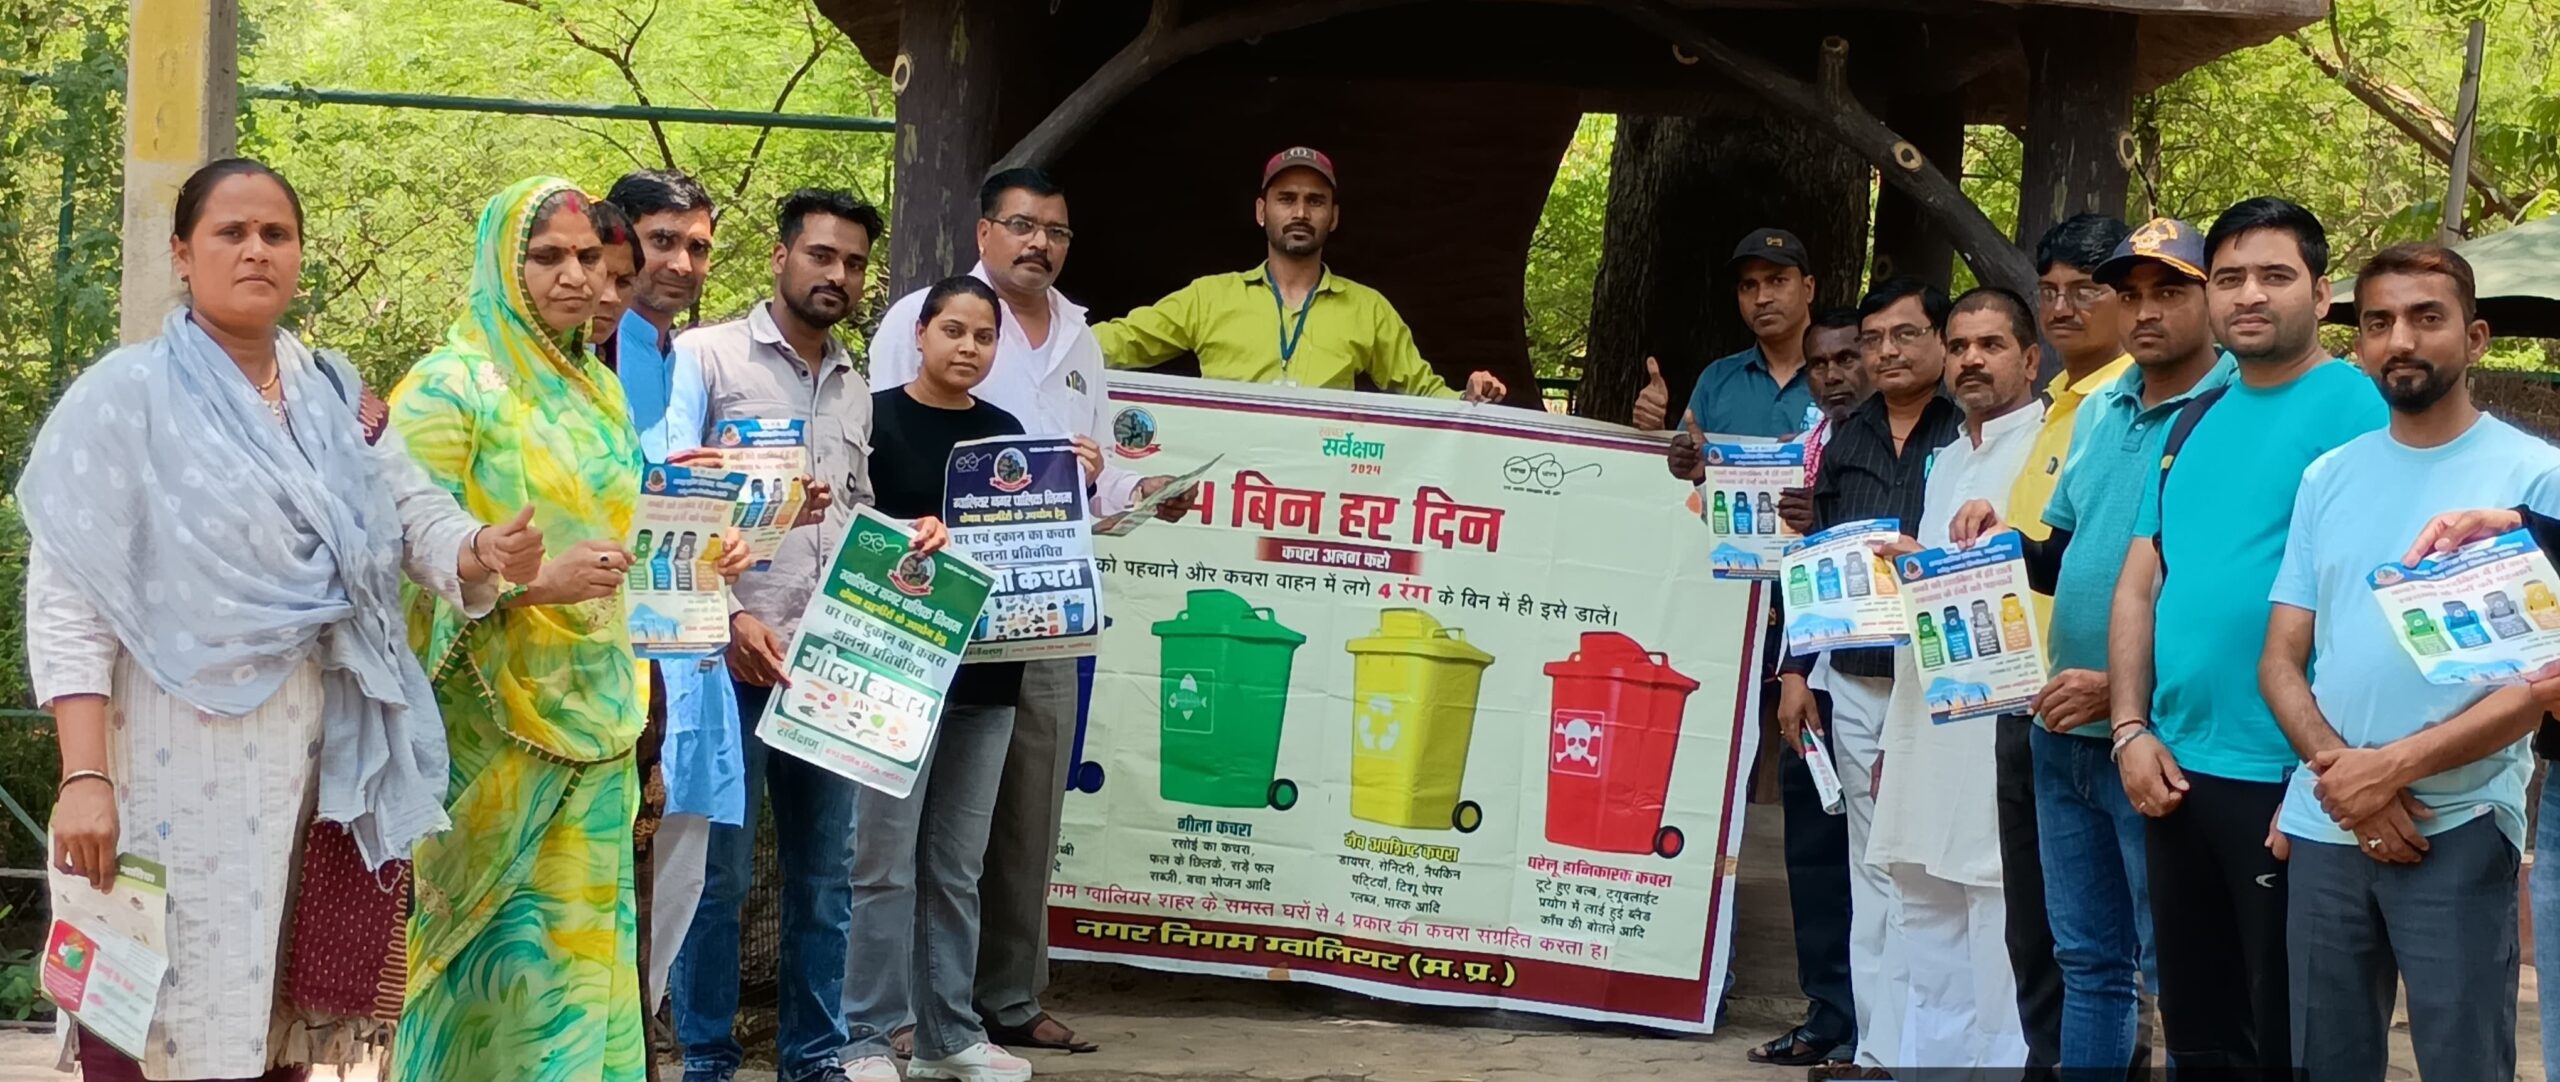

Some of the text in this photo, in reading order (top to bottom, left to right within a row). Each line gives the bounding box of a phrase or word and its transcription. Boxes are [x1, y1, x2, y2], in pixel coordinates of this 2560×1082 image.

[1322, 432, 1385, 460] सर्वेक्षण
[1351, 463, 1381, 476] 2024
[1231, 470, 1325, 535] बिन
[1339, 491, 1400, 541] हर
[1412, 486, 1505, 552] दिन
[954, 528, 1076, 547] घर एवं दुकान का कचरा
[1281, 545, 1391, 570] कचरा अलग करो
[1015, 565, 1082, 591] कचरा
[1123, 559, 1178, 580] पहचाने
[1185, 561, 1217, 582] और
[1223, 568, 1269, 587] कचरा
[1276, 573, 1316, 591] वाहन
[1323, 572, 1337, 593] में
[1342, 575, 1371, 596] लगे
[1378, 583, 1392, 599] 4
[1398, 577, 1432, 604] रंग
[1438, 585, 1455, 605] के
[1497, 592, 1510, 612] में
[1517, 594, 1533, 616] ही
[1540, 599, 1567, 620] इसे
[825, 604, 841, 620] घर
[898, 637, 915, 652] का
[916, 647, 948, 668] कचरा
[832, 629, 871, 654] डालना
[801, 643, 866, 692] गीला
[1177, 815, 1252, 838] गीला कचरा
[1171, 837, 1256, 857] रसोई का कचरा,
[1420, 844, 1460, 862] कचरा
[1149, 853, 1170, 865] फल
[1174, 853, 1185, 866] के
[1254, 862, 1275, 874] फल
[1528, 854, 1673, 888] घरेलू हानिकारक कचरा
[1211, 874, 1242, 889] भोजन
[1245, 877, 1271, 892] आदि
[1422, 881, 1443, 896] पेपर
[1536, 877, 1552, 893] टूटे
[1556, 882, 1571, 896] हुए
[1384, 897, 1411, 911] मास्क
[1415, 900, 1441, 914] आदि
[1538, 896, 1567, 910] प्रयोग
[1572, 899, 1581, 912] में
[1584, 902, 1605, 917] लाई
[1084, 884, 1151, 906] ग्वालियर
[1158, 892, 1195, 911] शहर
[1201, 892, 1218, 913] के
[1226, 898, 1275, 917] समस्त
[1282, 900, 1310, 920] घरों
[1315, 903, 1329, 923] से
[1335, 911, 1345, 926] 4
[1352, 912, 1392, 931] प्रकार
[1397, 919, 1418, 937] का
[1426, 923, 1470, 941] कचरा
[1476, 924, 1531, 949] संग्रहित
[1539, 937, 1583, 957] करता
[1568, 914, 1582, 930] की
[1619, 924, 1646, 939] आदि
[1075, 919, 1516, 987] नगर निगम ग्वालियर (म.प्र.)
